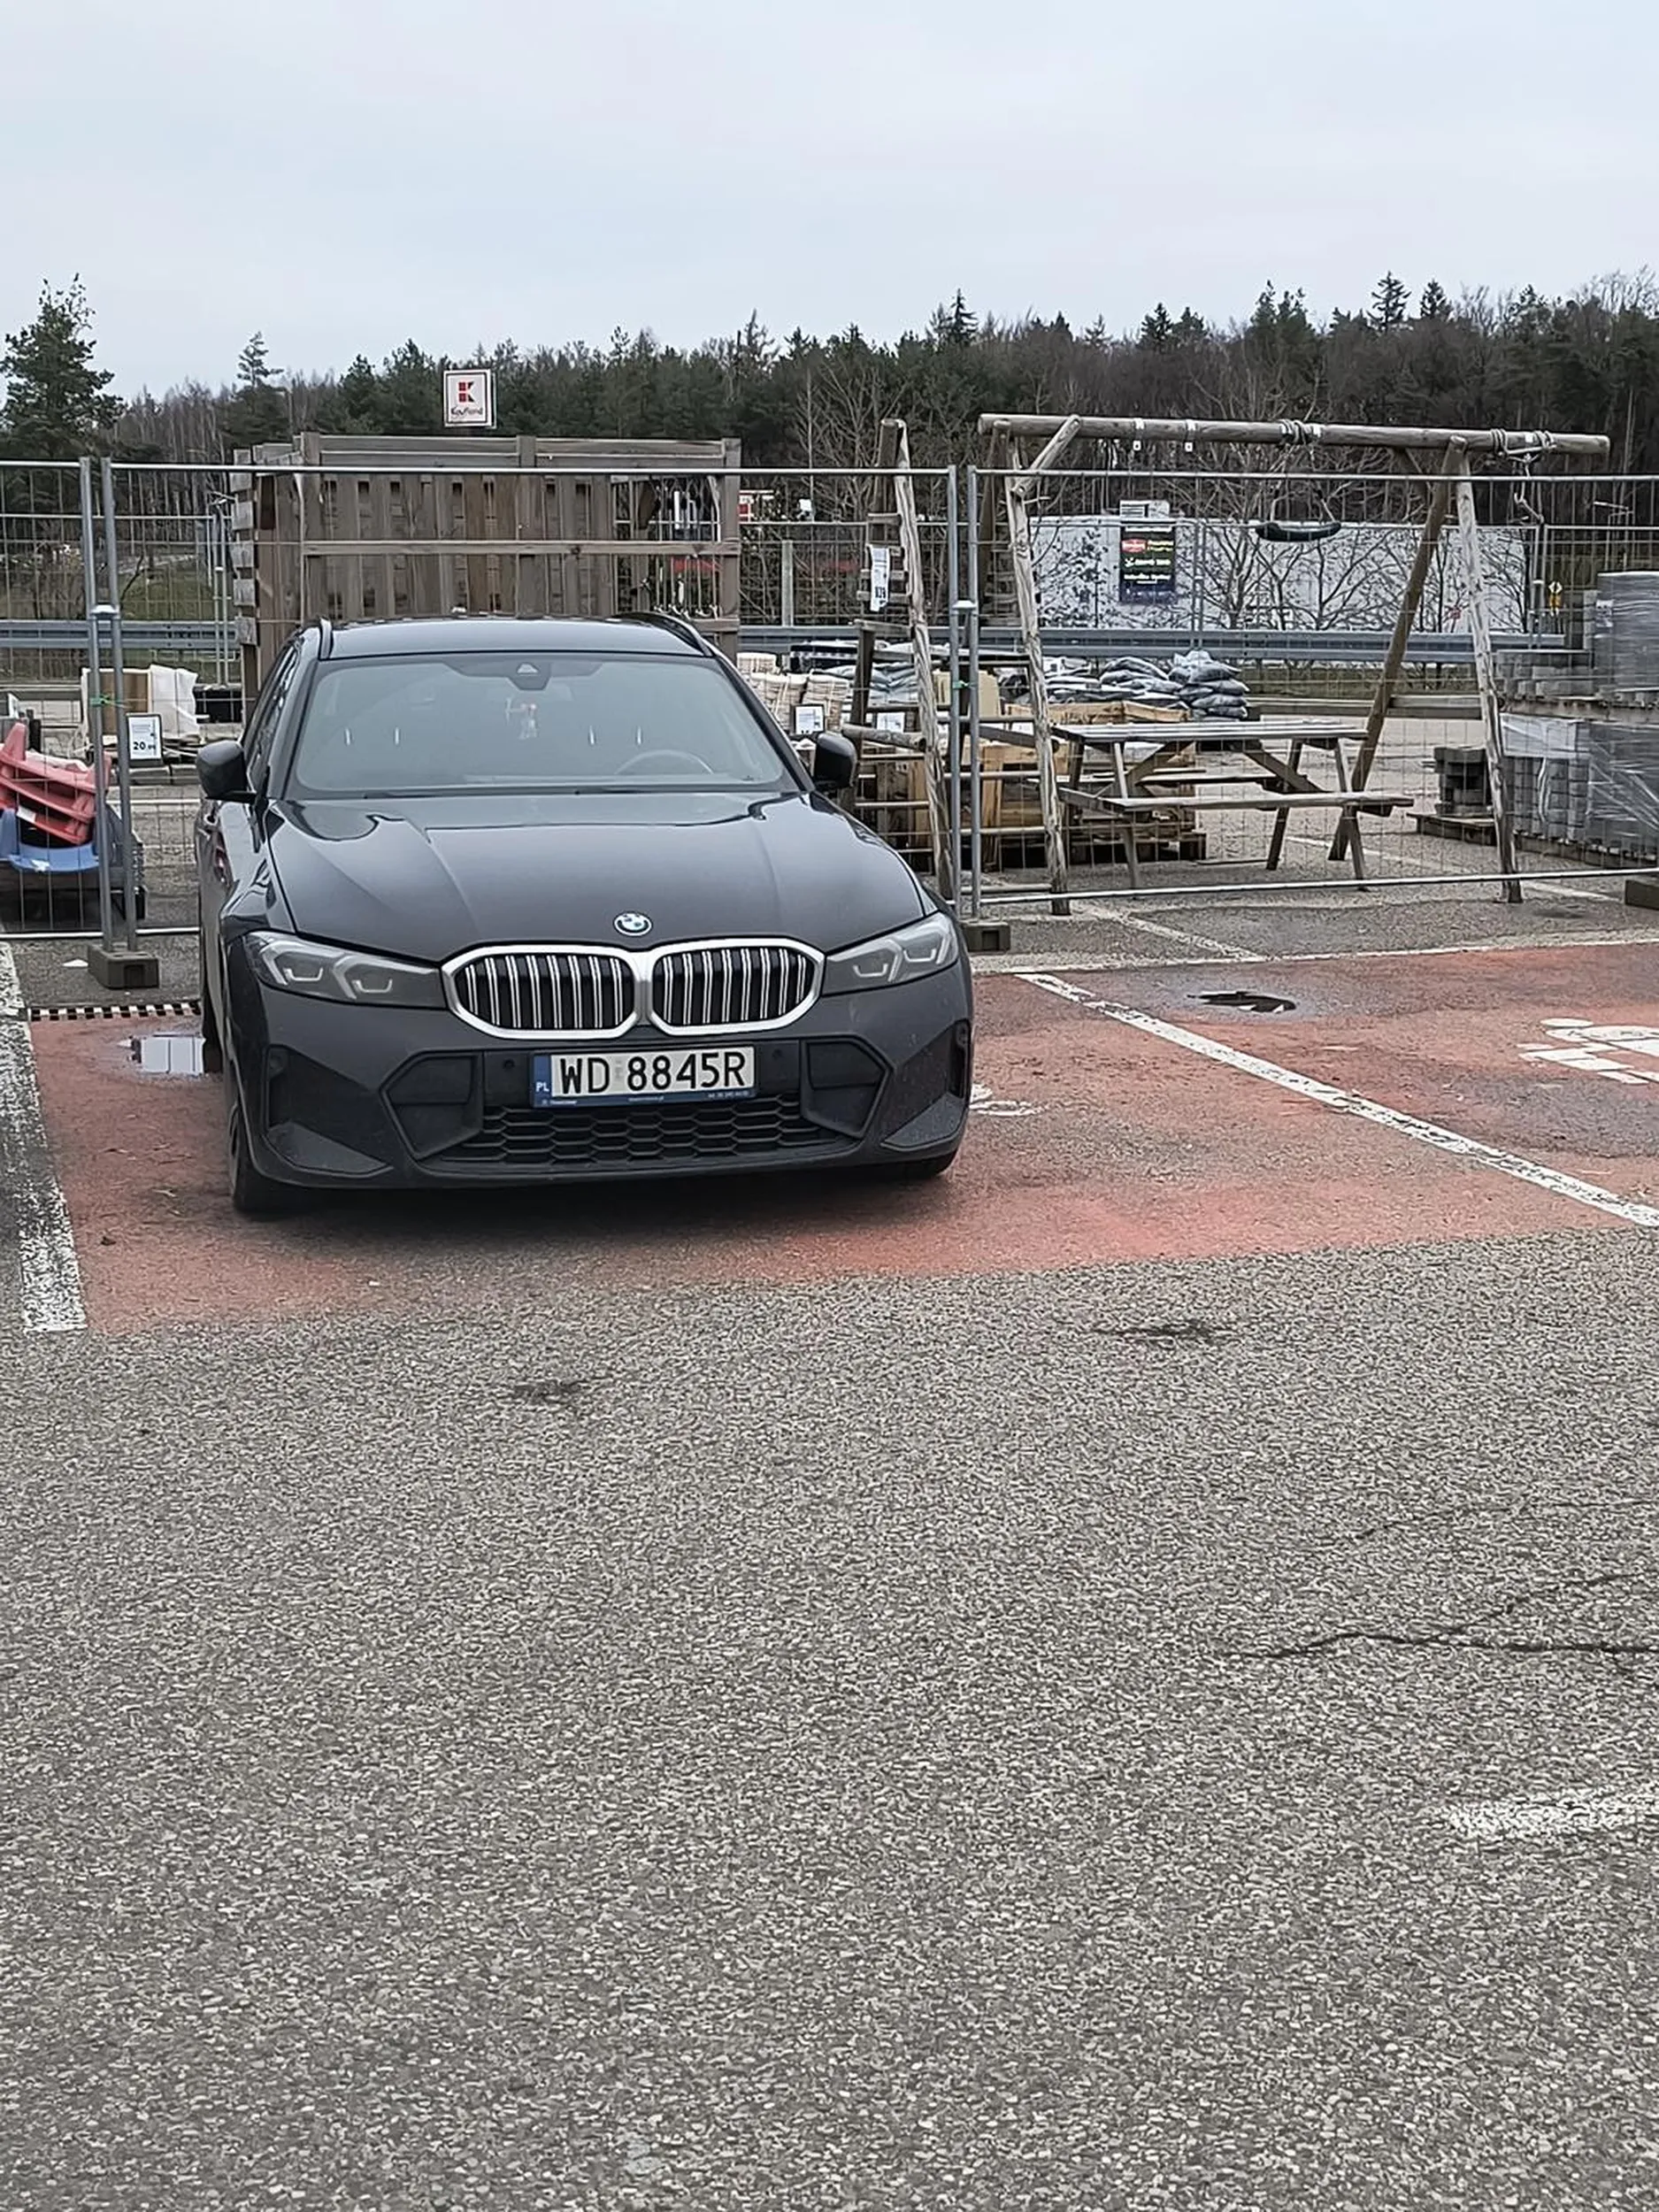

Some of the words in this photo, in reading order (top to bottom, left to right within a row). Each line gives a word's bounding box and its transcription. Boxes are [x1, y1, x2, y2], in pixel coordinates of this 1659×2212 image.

[450, 406, 483, 418] Kaufd
[133, 741, 146, 750] 20
[560, 1057, 610, 1094] WD
[626, 1051, 745, 1092] 8845R
[535, 1081, 550, 1093] PL
